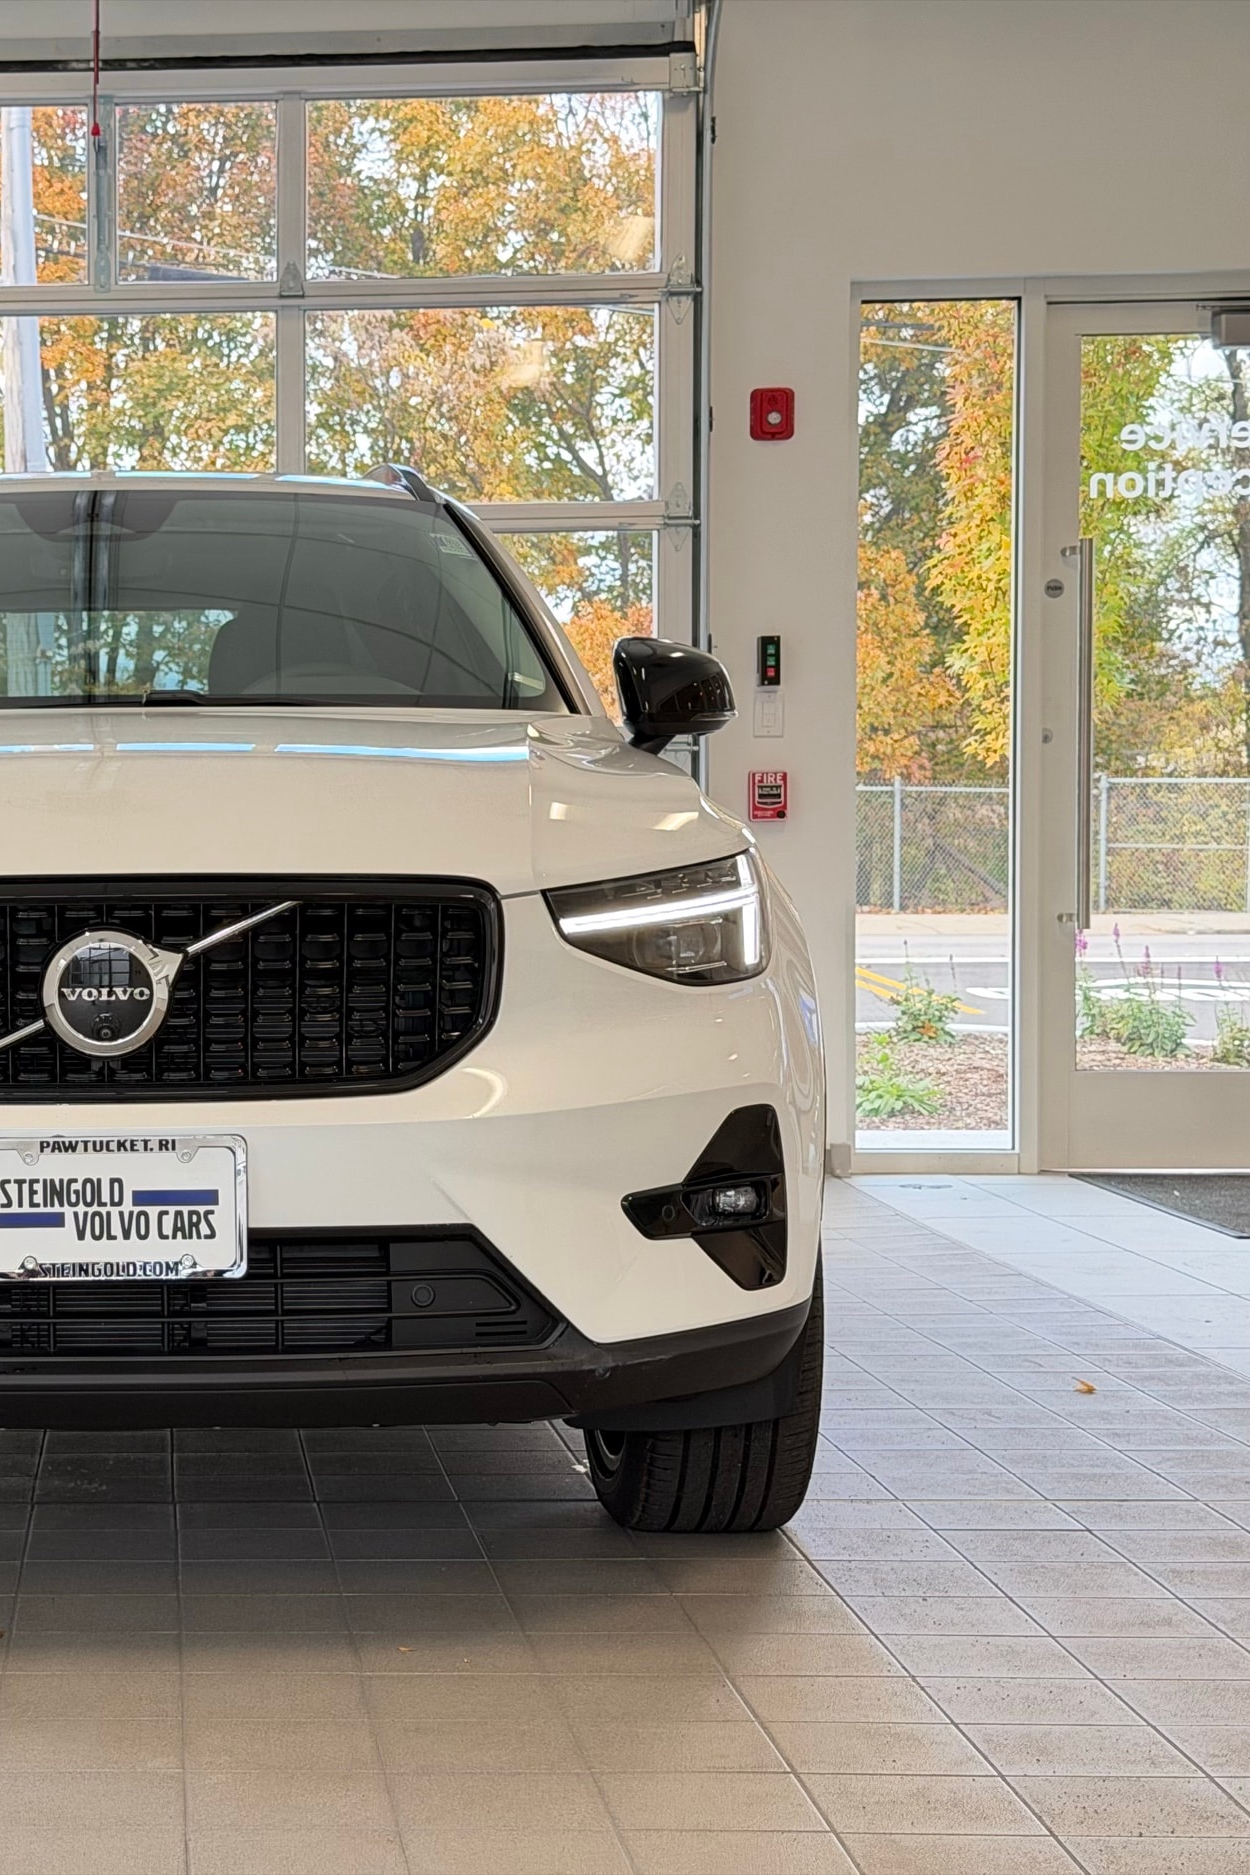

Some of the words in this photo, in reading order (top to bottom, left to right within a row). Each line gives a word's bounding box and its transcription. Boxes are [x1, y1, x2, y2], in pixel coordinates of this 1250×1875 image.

[754, 773, 784, 784] FIRE
[60, 987, 150, 1001] VOLVO
[160, 1139, 177, 1151] RI
[0, 1177, 124, 1208] STEINGOLD
[73, 1210, 150, 1241] VOLVO
[157, 1209, 216, 1240] CARS
[38, 1261, 180, 1278] STEINGOLD.COM
